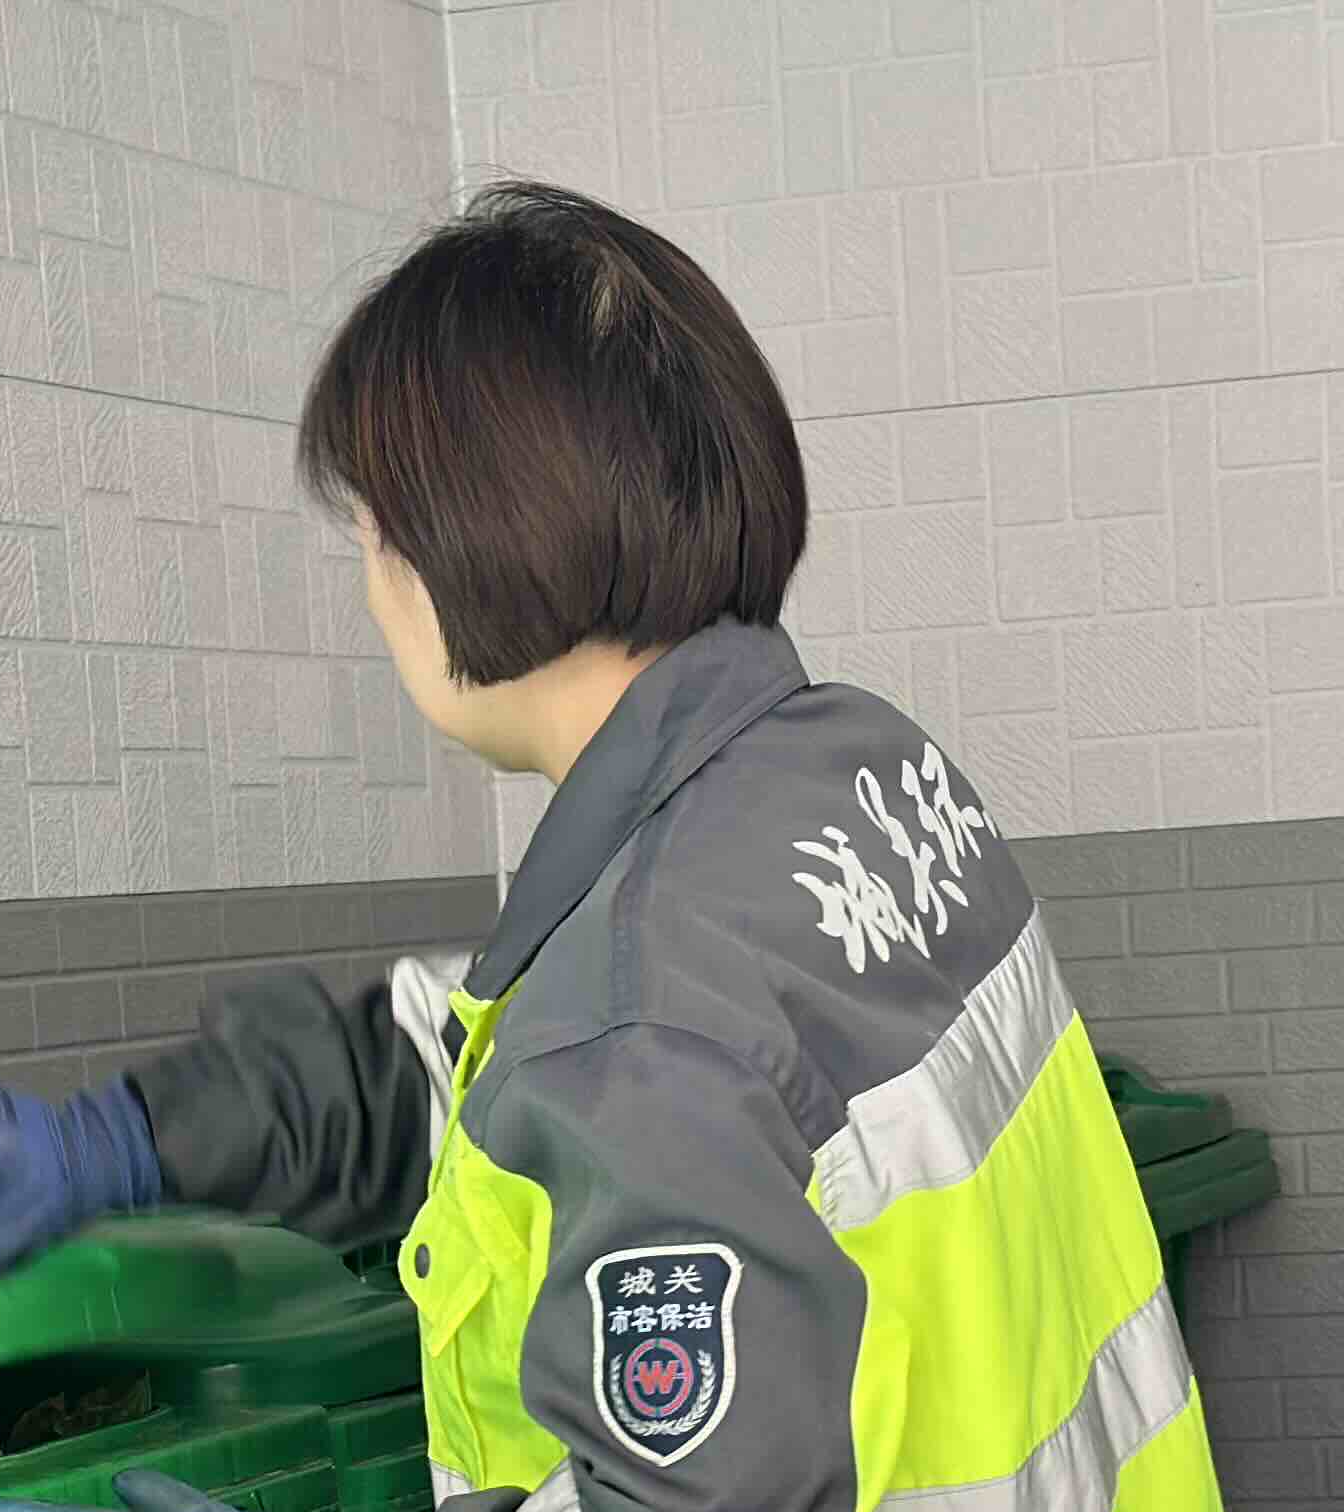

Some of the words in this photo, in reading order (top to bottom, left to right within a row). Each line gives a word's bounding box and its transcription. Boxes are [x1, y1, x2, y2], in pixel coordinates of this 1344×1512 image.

[792, 741, 998, 973] 城关环
[617, 1264, 704, 1298] 城关
